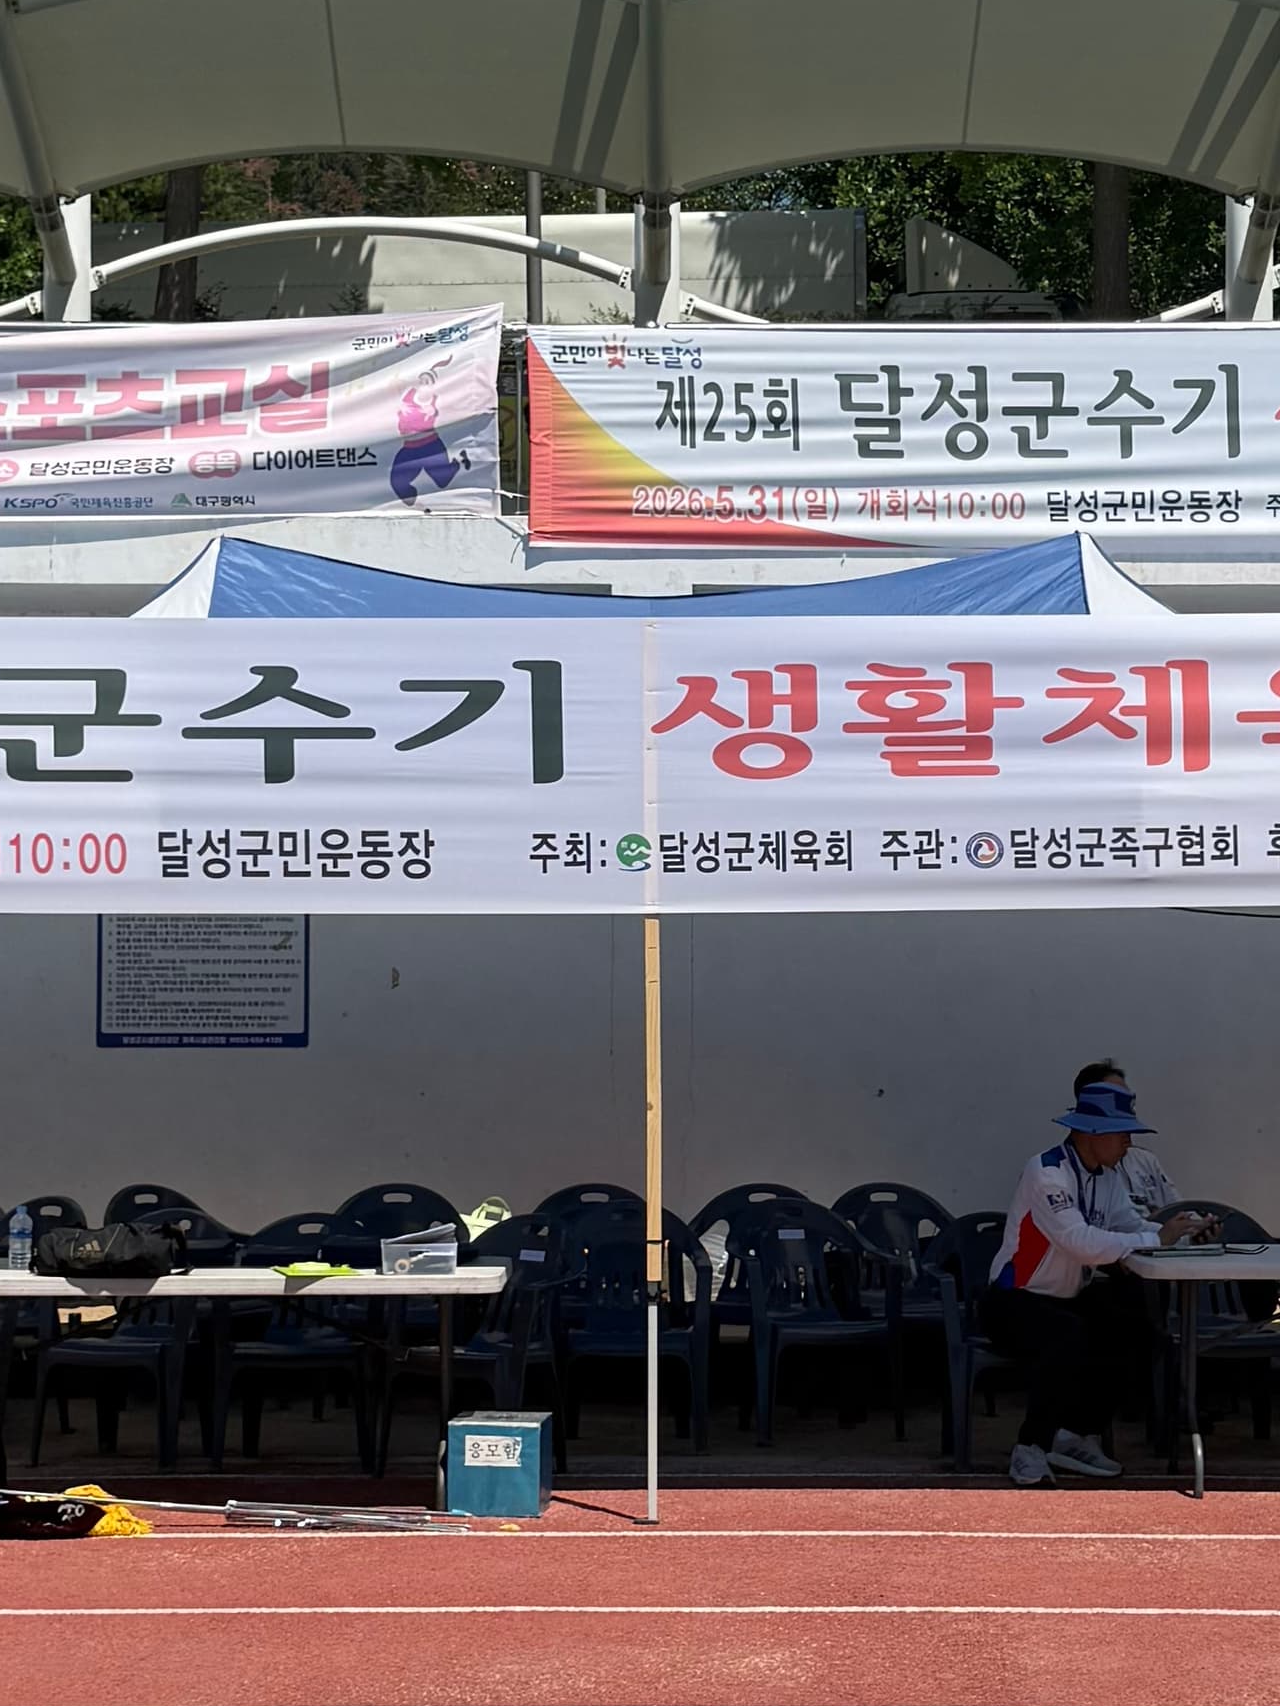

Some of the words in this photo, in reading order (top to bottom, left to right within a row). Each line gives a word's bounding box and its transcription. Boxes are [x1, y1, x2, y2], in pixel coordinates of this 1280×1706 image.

[550, 345, 602, 364] 군민이
[605, 341, 660, 369] 빛나는
[662, 343, 702, 369] 달성
[655, 375, 801, 452] 제25회
[834, 363, 1242, 459] 달성군수기
[29, 456, 176, 477] 달성군민운동장
[253, 447, 378, 471] 다이어트댄스
[4, 496, 59, 509] KSPO
[195, 495, 256, 507] 대구광역시
[632, 486, 839, 525] 2026.5.31(일)
[857, 486, 1027, 522] 개회식10:00
[1046, 489, 1243, 525] 달성군민운동장
[156, 828, 436, 879] 달성군민운동장
[529, 831, 607, 875] 주최:
[656, 829, 855, 875] 달성군체육회
[878, 826, 959, 867] 주관:
[1007, 825, 1240, 870] 달성군족구협회
[468, 1441, 519, 1460] 응모함
